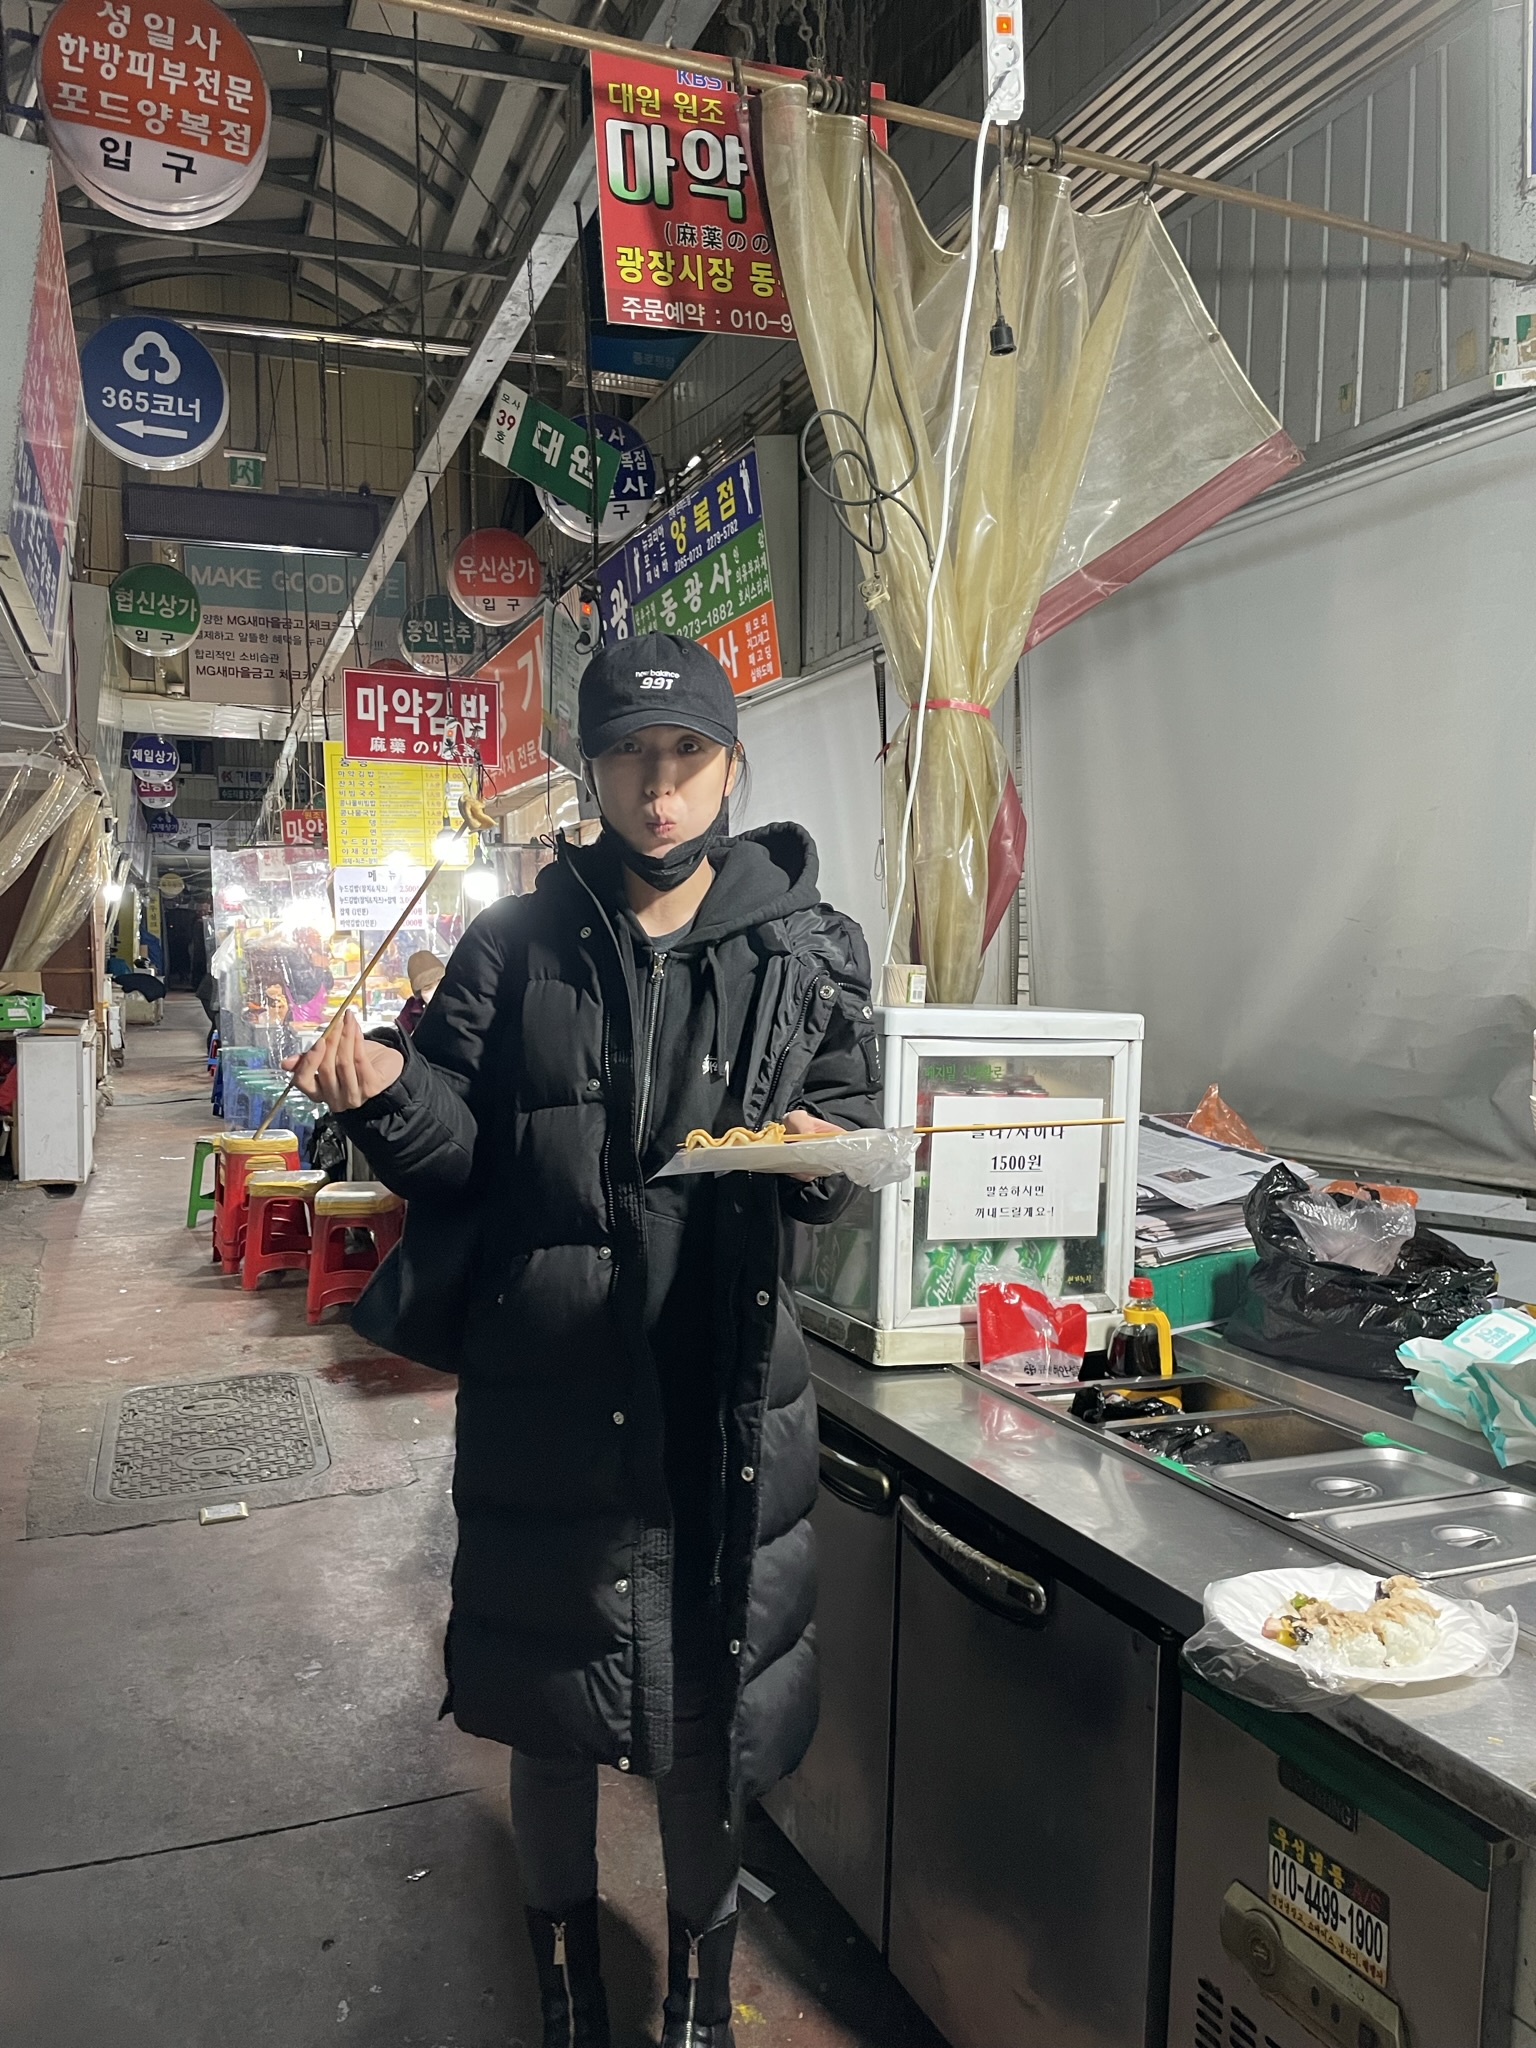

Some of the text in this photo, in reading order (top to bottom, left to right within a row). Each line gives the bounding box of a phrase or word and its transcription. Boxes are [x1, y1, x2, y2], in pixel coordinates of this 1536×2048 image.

[97, 1, 222, 61] 성일사
[57, 32, 254, 114] 한방피부전문
[676, 69, 723, 91] KBS
[52, 81, 252, 157] 포드양복점
[607, 82, 726, 125] 대원 원조
[604, 118, 750, 222] 마약
[616, 246, 785, 298] 광장시장 동
[621, 296, 706, 326] 주문예약
[101, 386, 201, 423] 365코너
[496, 409, 516, 431] 39
[531, 419, 602, 491] 대원
[620, 449, 648, 472] 복점
[670, 475, 736, 555] 양복점
[673, 518, 739, 574] 2265-0733 2279-5782
[191, 564, 263, 590] MAKE
[271, 570, 345, 595] GOOD
[458, 555, 535, 585] 우신상가
[114, 587, 198, 623] 협신상가
[659, 552, 733, 628] 동광사
[227, 614, 305, 630] MG새마을금고
[195, 649, 280, 663] 합리적인 소비습관
[196, 665, 275, 681] MG새마을금고
[640, 677, 674, 690] 991
[356, 684, 490, 740] 마약김밥
[131, 748, 177, 766] 제일상가
[991, 1154, 1042, 1171] 1500원
[986, 1185, 1045, 1197] 말씀하시면
[1272, 1849, 1384, 1965] 010-4499-1900
